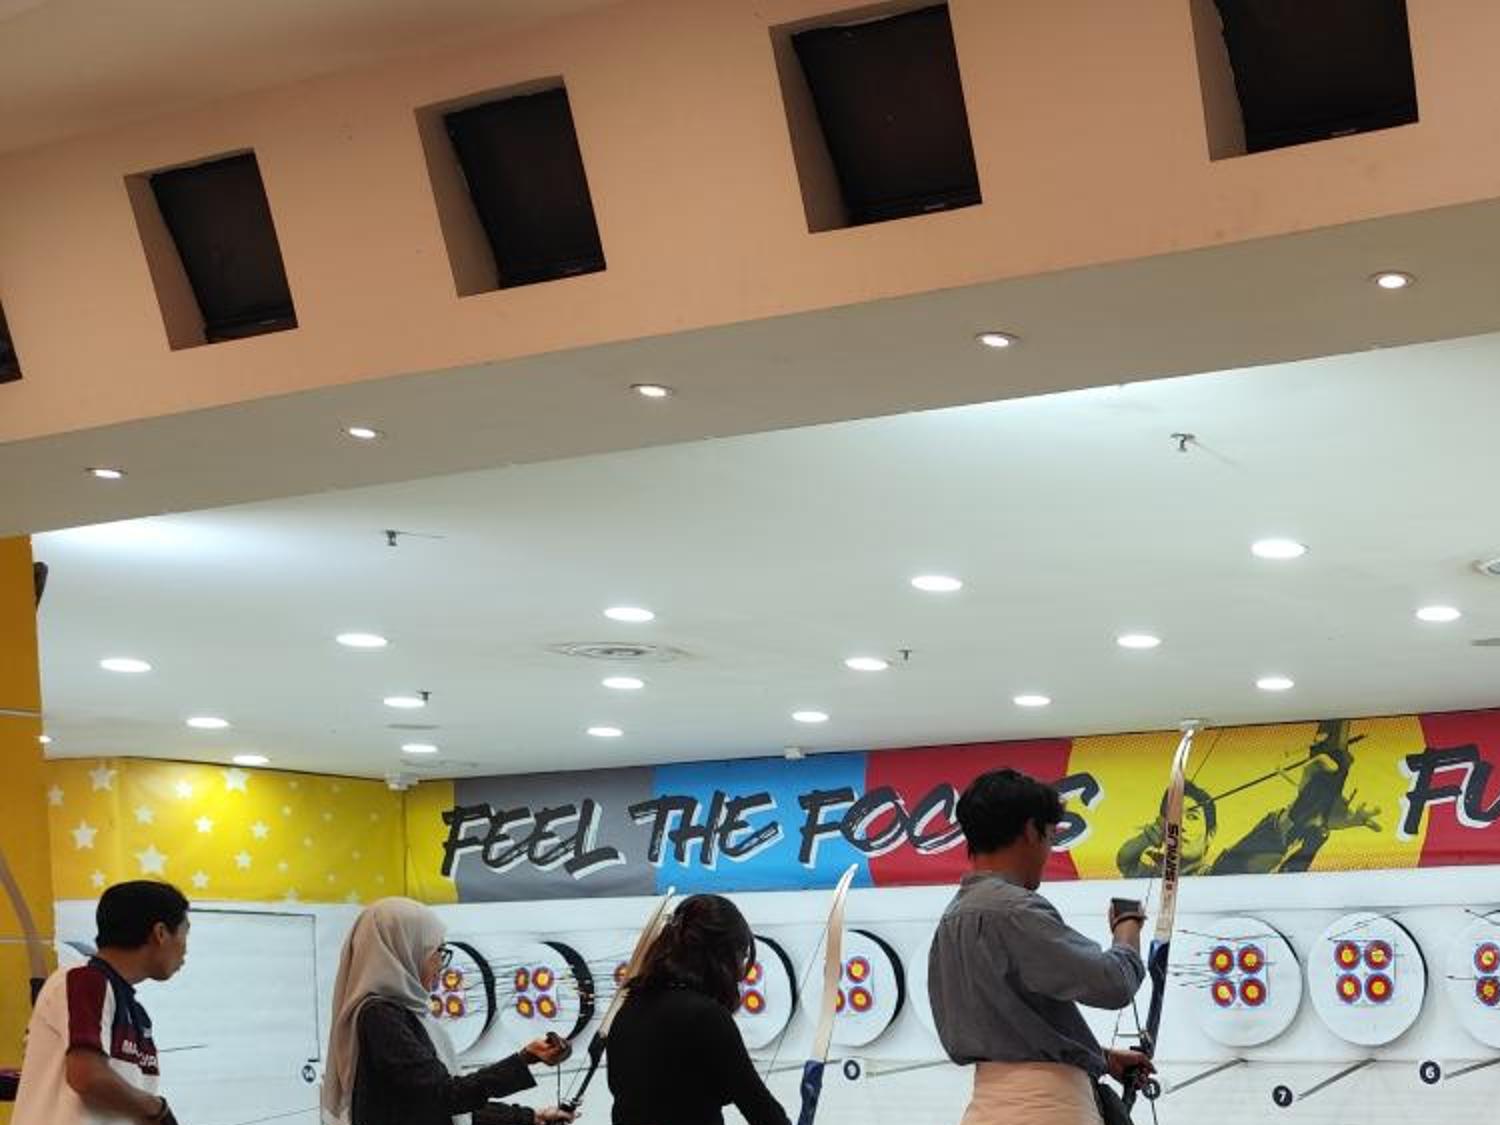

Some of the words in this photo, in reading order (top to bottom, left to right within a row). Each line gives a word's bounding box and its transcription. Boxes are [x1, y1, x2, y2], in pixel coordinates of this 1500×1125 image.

[443, 799, 625, 880] FEEL
[629, 790, 784, 869] THE
[798, 772, 1103, 868] FOCS
